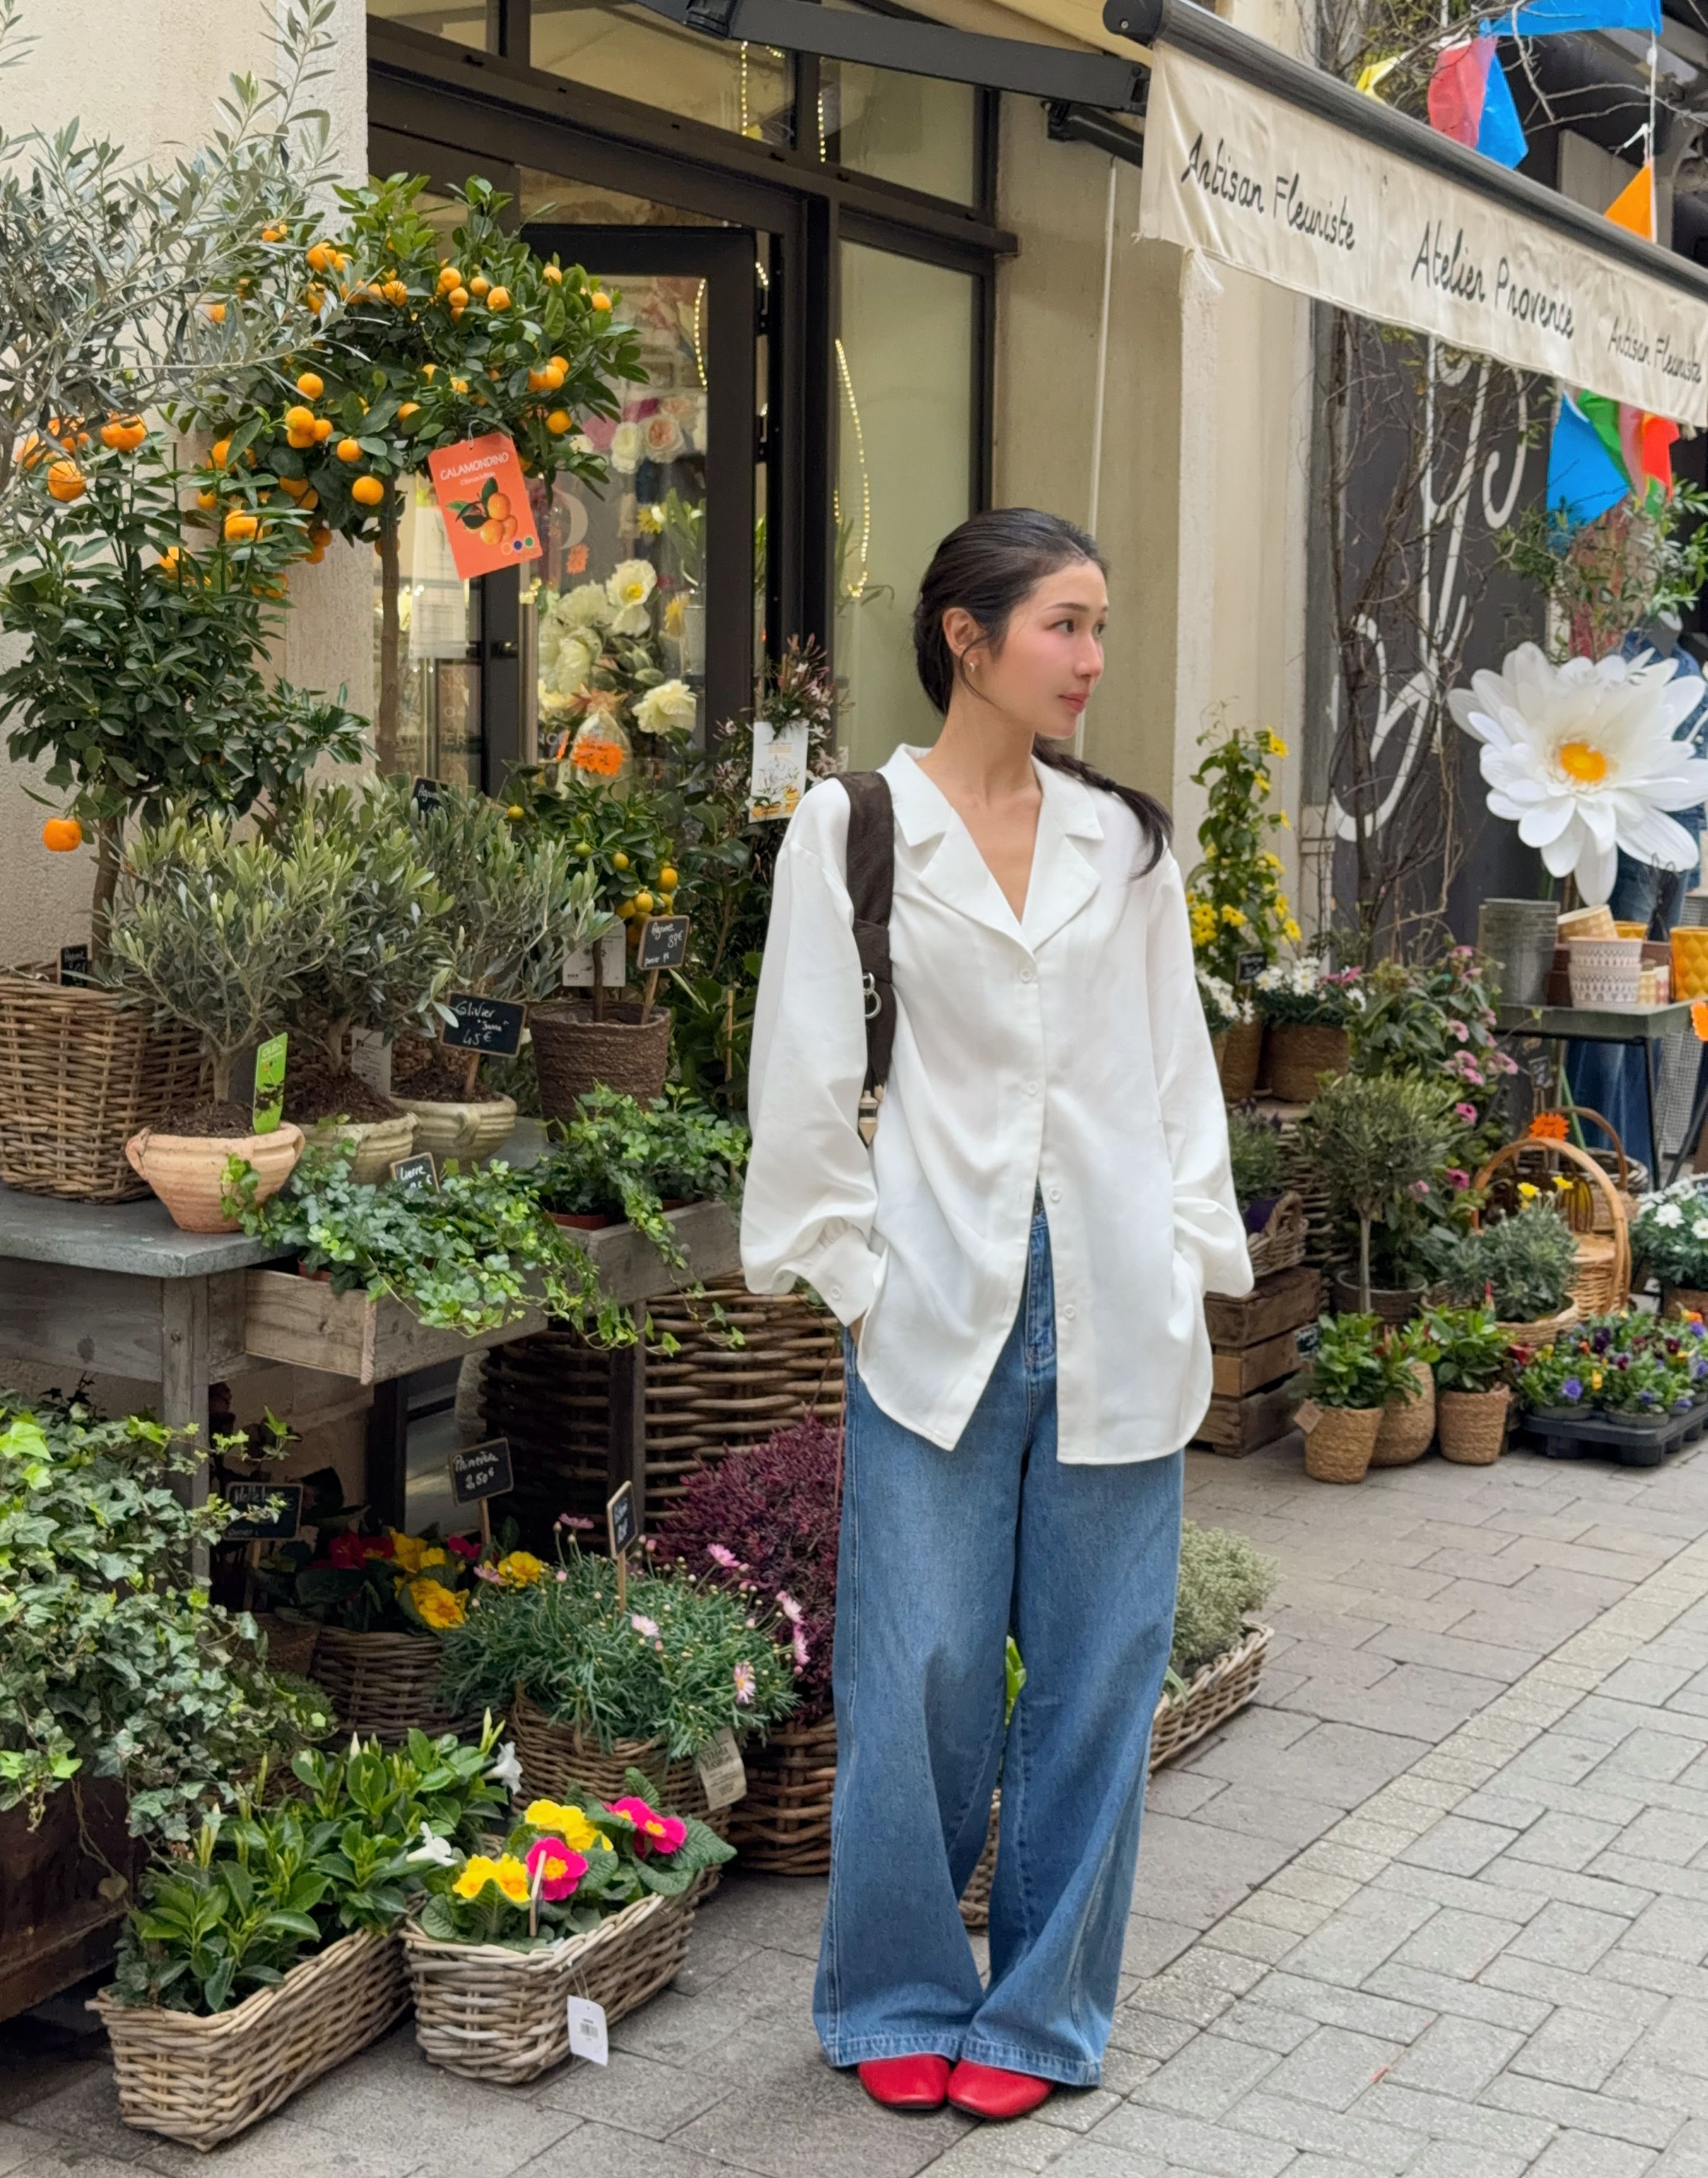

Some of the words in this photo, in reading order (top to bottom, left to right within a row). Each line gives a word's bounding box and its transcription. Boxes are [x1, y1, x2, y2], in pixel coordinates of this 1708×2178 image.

[1181, 133, 1265, 214] Artisan
[1272, 173, 1356, 250] Fleuriste
[1411, 220, 1486, 304] Atelier
[1494, 257, 1574, 338] Provence
[1608, 317, 1651, 366] Artisan
[1656, 337, 1703, 384] Fleuriste
[440, 452, 509, 481] CALAMONDINO
